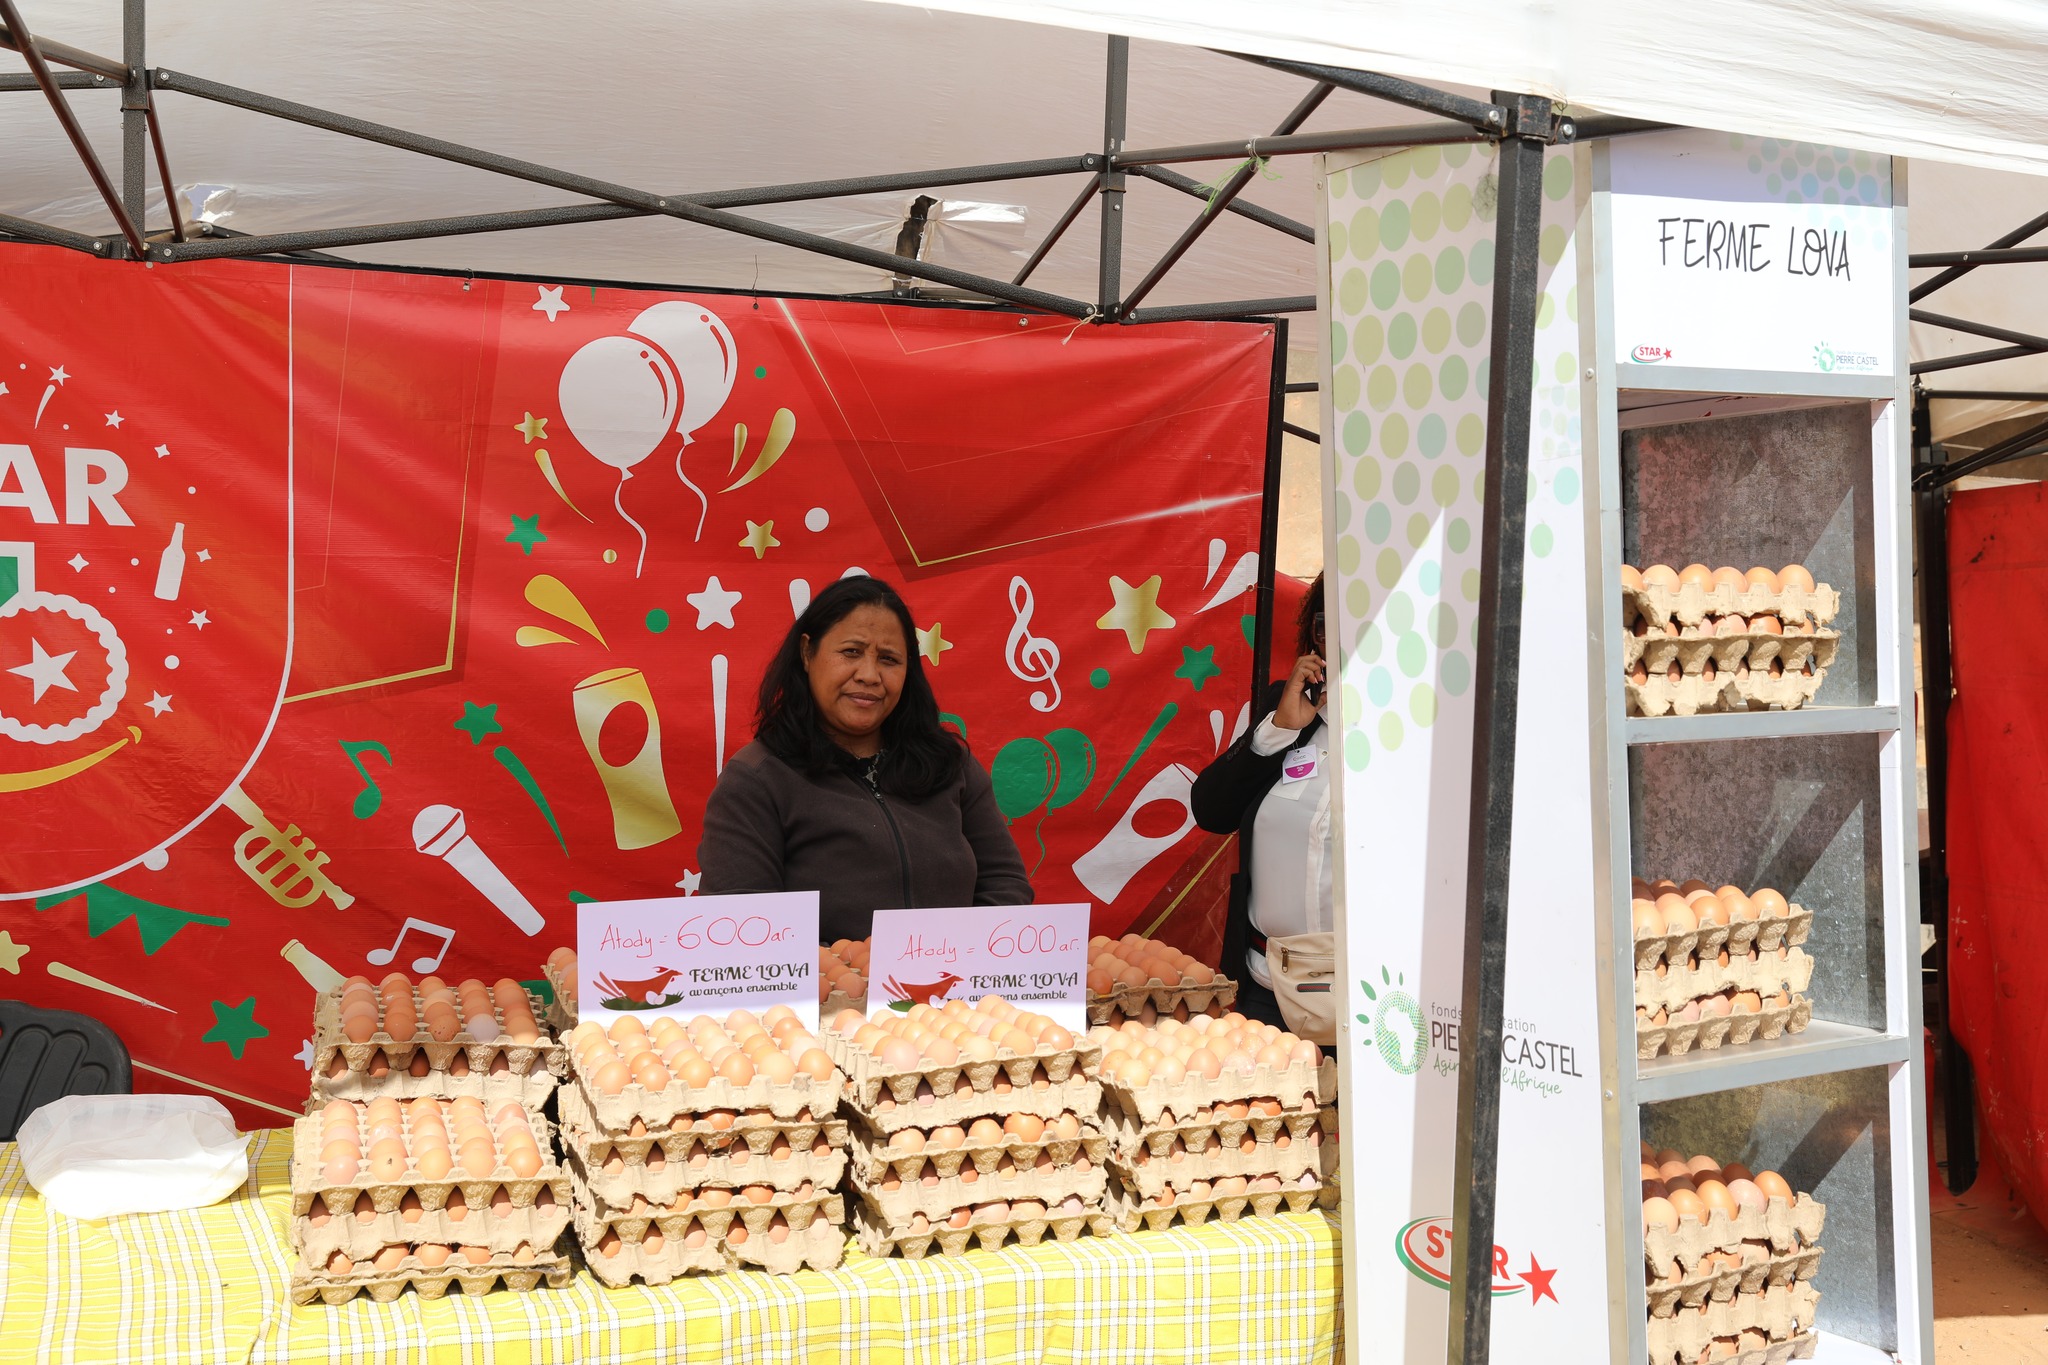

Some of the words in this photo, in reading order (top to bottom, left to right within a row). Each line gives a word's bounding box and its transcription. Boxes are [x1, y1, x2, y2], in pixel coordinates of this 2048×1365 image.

[1658, 217, 1770, 273] FERME
[1787, 226, 1851, 282] LOVA
[1639, 346, 1661, 356] STAR
[1836, 355, 1855, 364] PIERRE
[1856, 356, 1879, 366] CASTEL
[600, 924, 653, 958] Atody
[897, 934, 957, 963] Atody
[689, 965, 752, 984] FERME
[756, 962, 809, 981] LOVA
[969, 973, 1027, 990] FERME
[1030, 972, 1078, 988] LOVA
[689, 986, 744, 998] avançons
[746, 981, 798, 993] ensemble
[1021, 990, 1068, 1000] ensemble
[1501, 1034, 1583, 1078] CASTEL
[1502, 1066, 1563, 1099] l'Afrique
